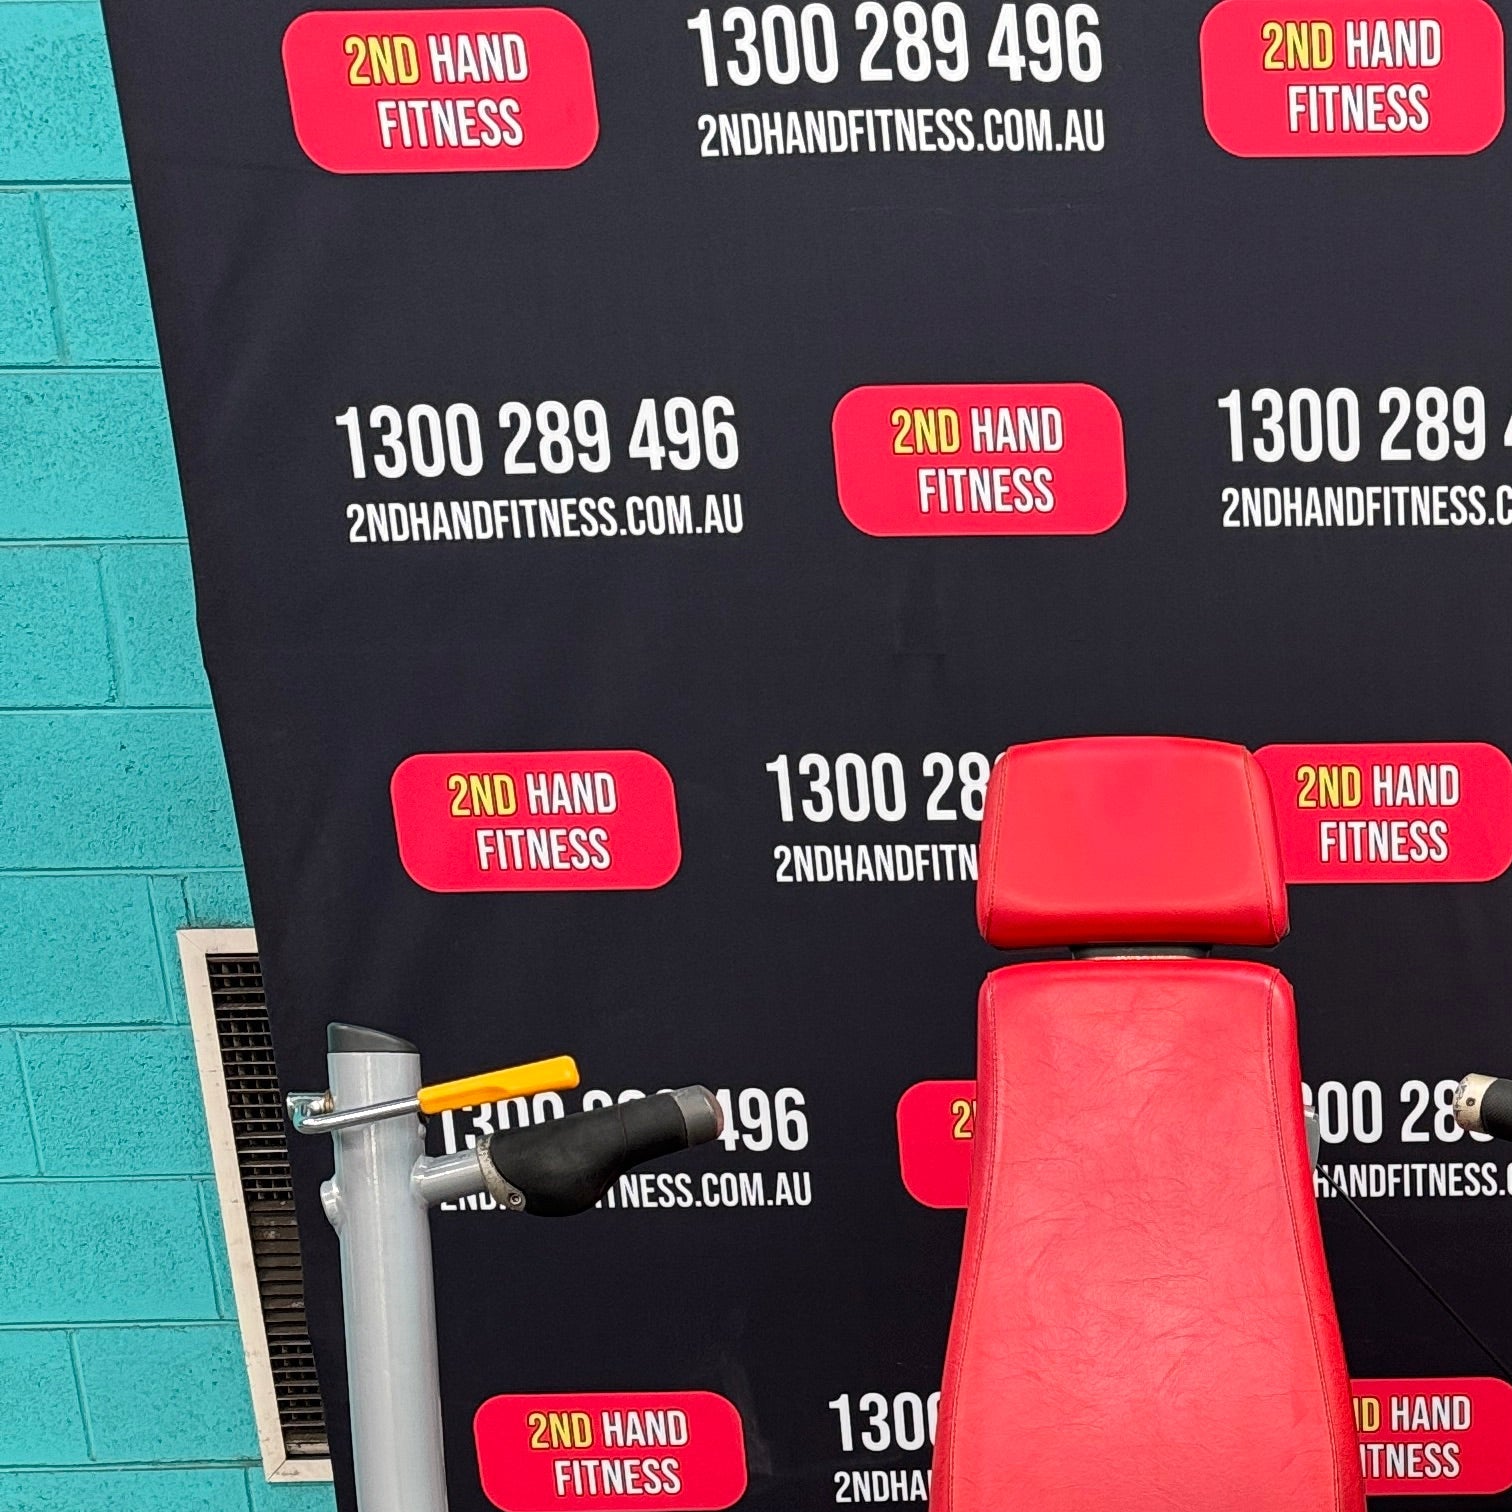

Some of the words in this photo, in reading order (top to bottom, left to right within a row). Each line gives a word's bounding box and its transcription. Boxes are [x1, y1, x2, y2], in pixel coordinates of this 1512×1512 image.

[344, 36, 419, 85] 2ND
[428, 33, 528, 83] HAND
[686, 2, 839, 87] 1300
[854, 0, 970, 83] 289
[987, 2, 1103, 83] 496
[1262, 21, 1334, 70] 2ND
[1346, 19, 1441, 68] HAND
[377, 98, 523, 148] FITNESS
[1288, 83, 1429, 132] FITNESS
[697, 107, 1105, 158] 2NDHANDFITNESS.COM.AU
[335, 402, 484, 479] 1300
[498, 399, 611, 475] 289
[628, 395, 739, 471] 496
[891, 408, 960, 454] 2ND
[970, 407, 1063, 452] HAND
[1217, 387, 1361, 463] 1300
[1378, 385, 1486, 462] 289
[918, 467, 1054, 513] FITNESS
[346, 493, 744, 543] 2NDHANDFITNESS.COM.AU
[448, 774, 517, 816] 2ND
[526, 772, 617, 814] HAND
[765, 752, 907, 823] 1300
[922, 751, 1006, 822] 28
[1297, 765, 1361, 808] 2ND
[1373, 764, 1459, 807] HAND
[476, 827, 611, 870] FITNESS
[773, 843, 979, 883] 2NDHANDFITN
[1320, 820, 1448, 862] FITNESS
[1400, 1079, 1496, 1144] 28
[528, 1412, 593, 1449] 2ND
[601, 1410, 688, 1447] HAND
[1391, 1395, 1471, 1431] HAND
[554, 1458, 681, 1496] FITNESS
[1360, 1441, 1461, 1480] ITNESS
